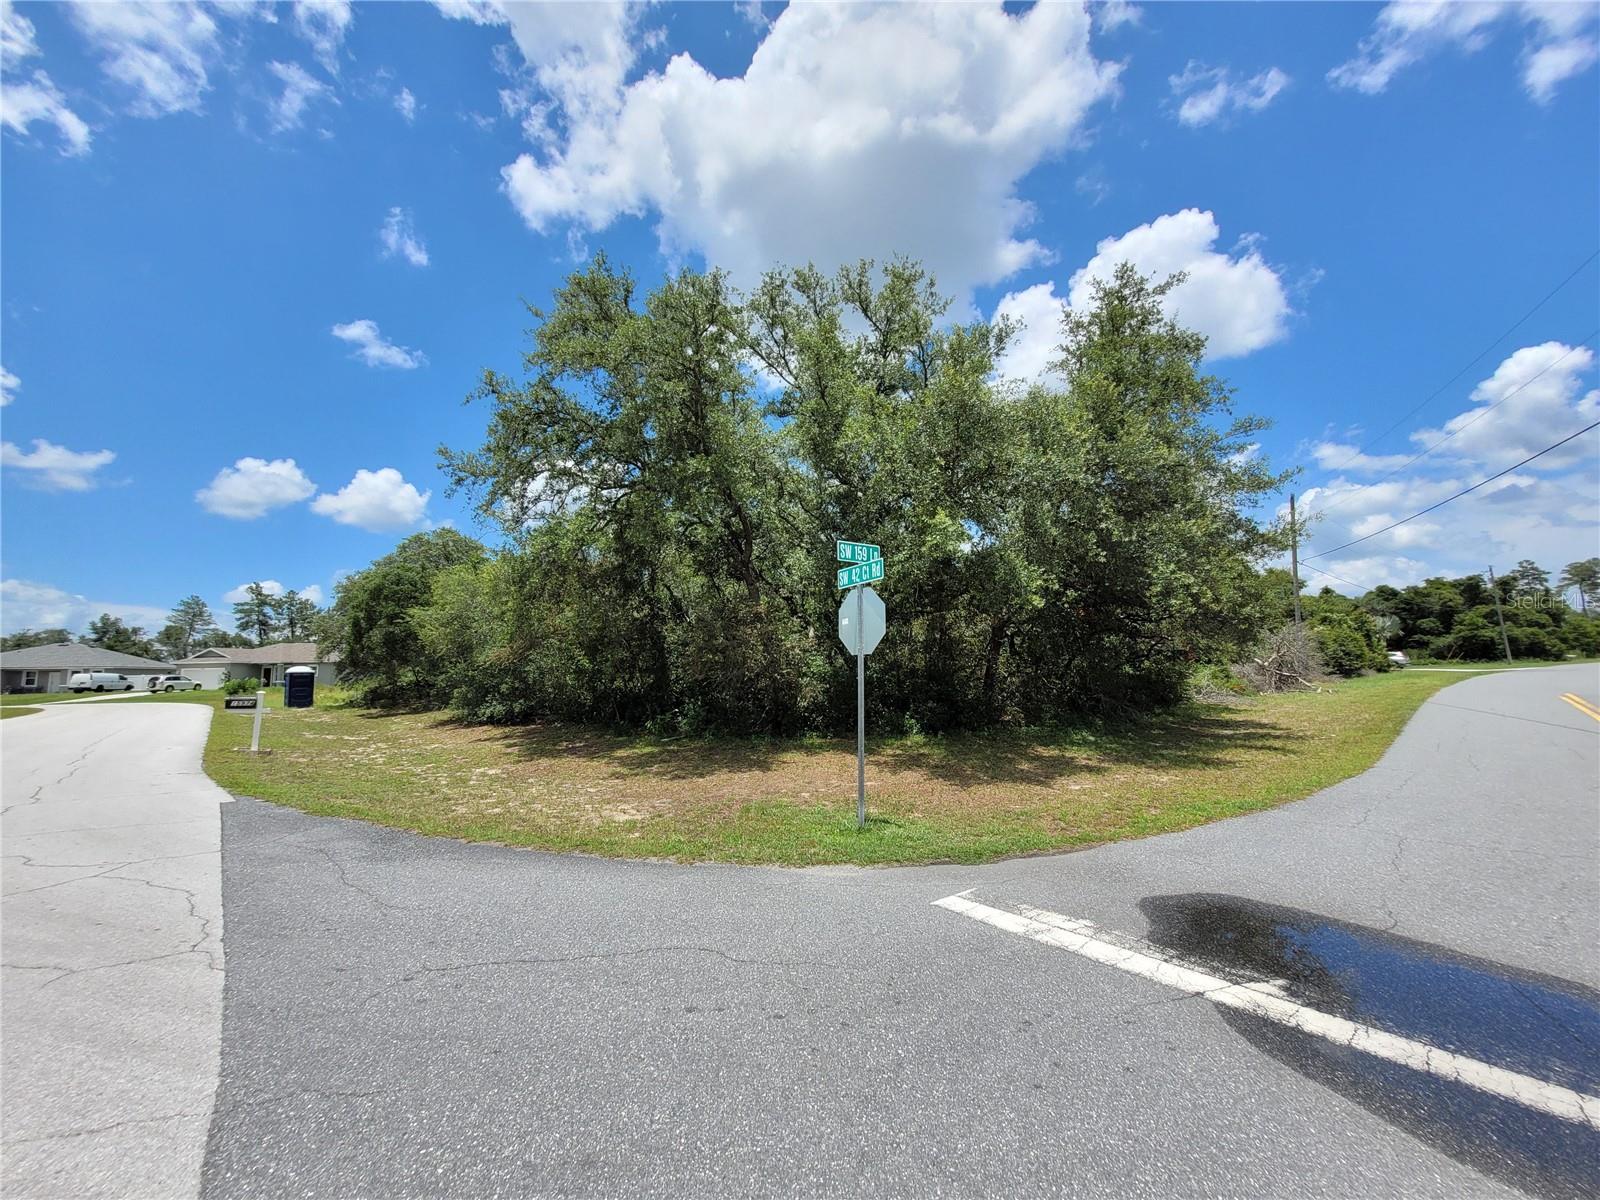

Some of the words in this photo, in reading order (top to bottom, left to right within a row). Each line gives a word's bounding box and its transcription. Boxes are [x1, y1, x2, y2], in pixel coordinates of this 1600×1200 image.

[840, 544, 851, 559] SW
[855, 546, 867, 561] 159
[839, 571, 848, 586] SW
[851, 568, 860, 583] 42
[862, 566, 869, 580] Ct
[872, 562, 880, 577] Rd
